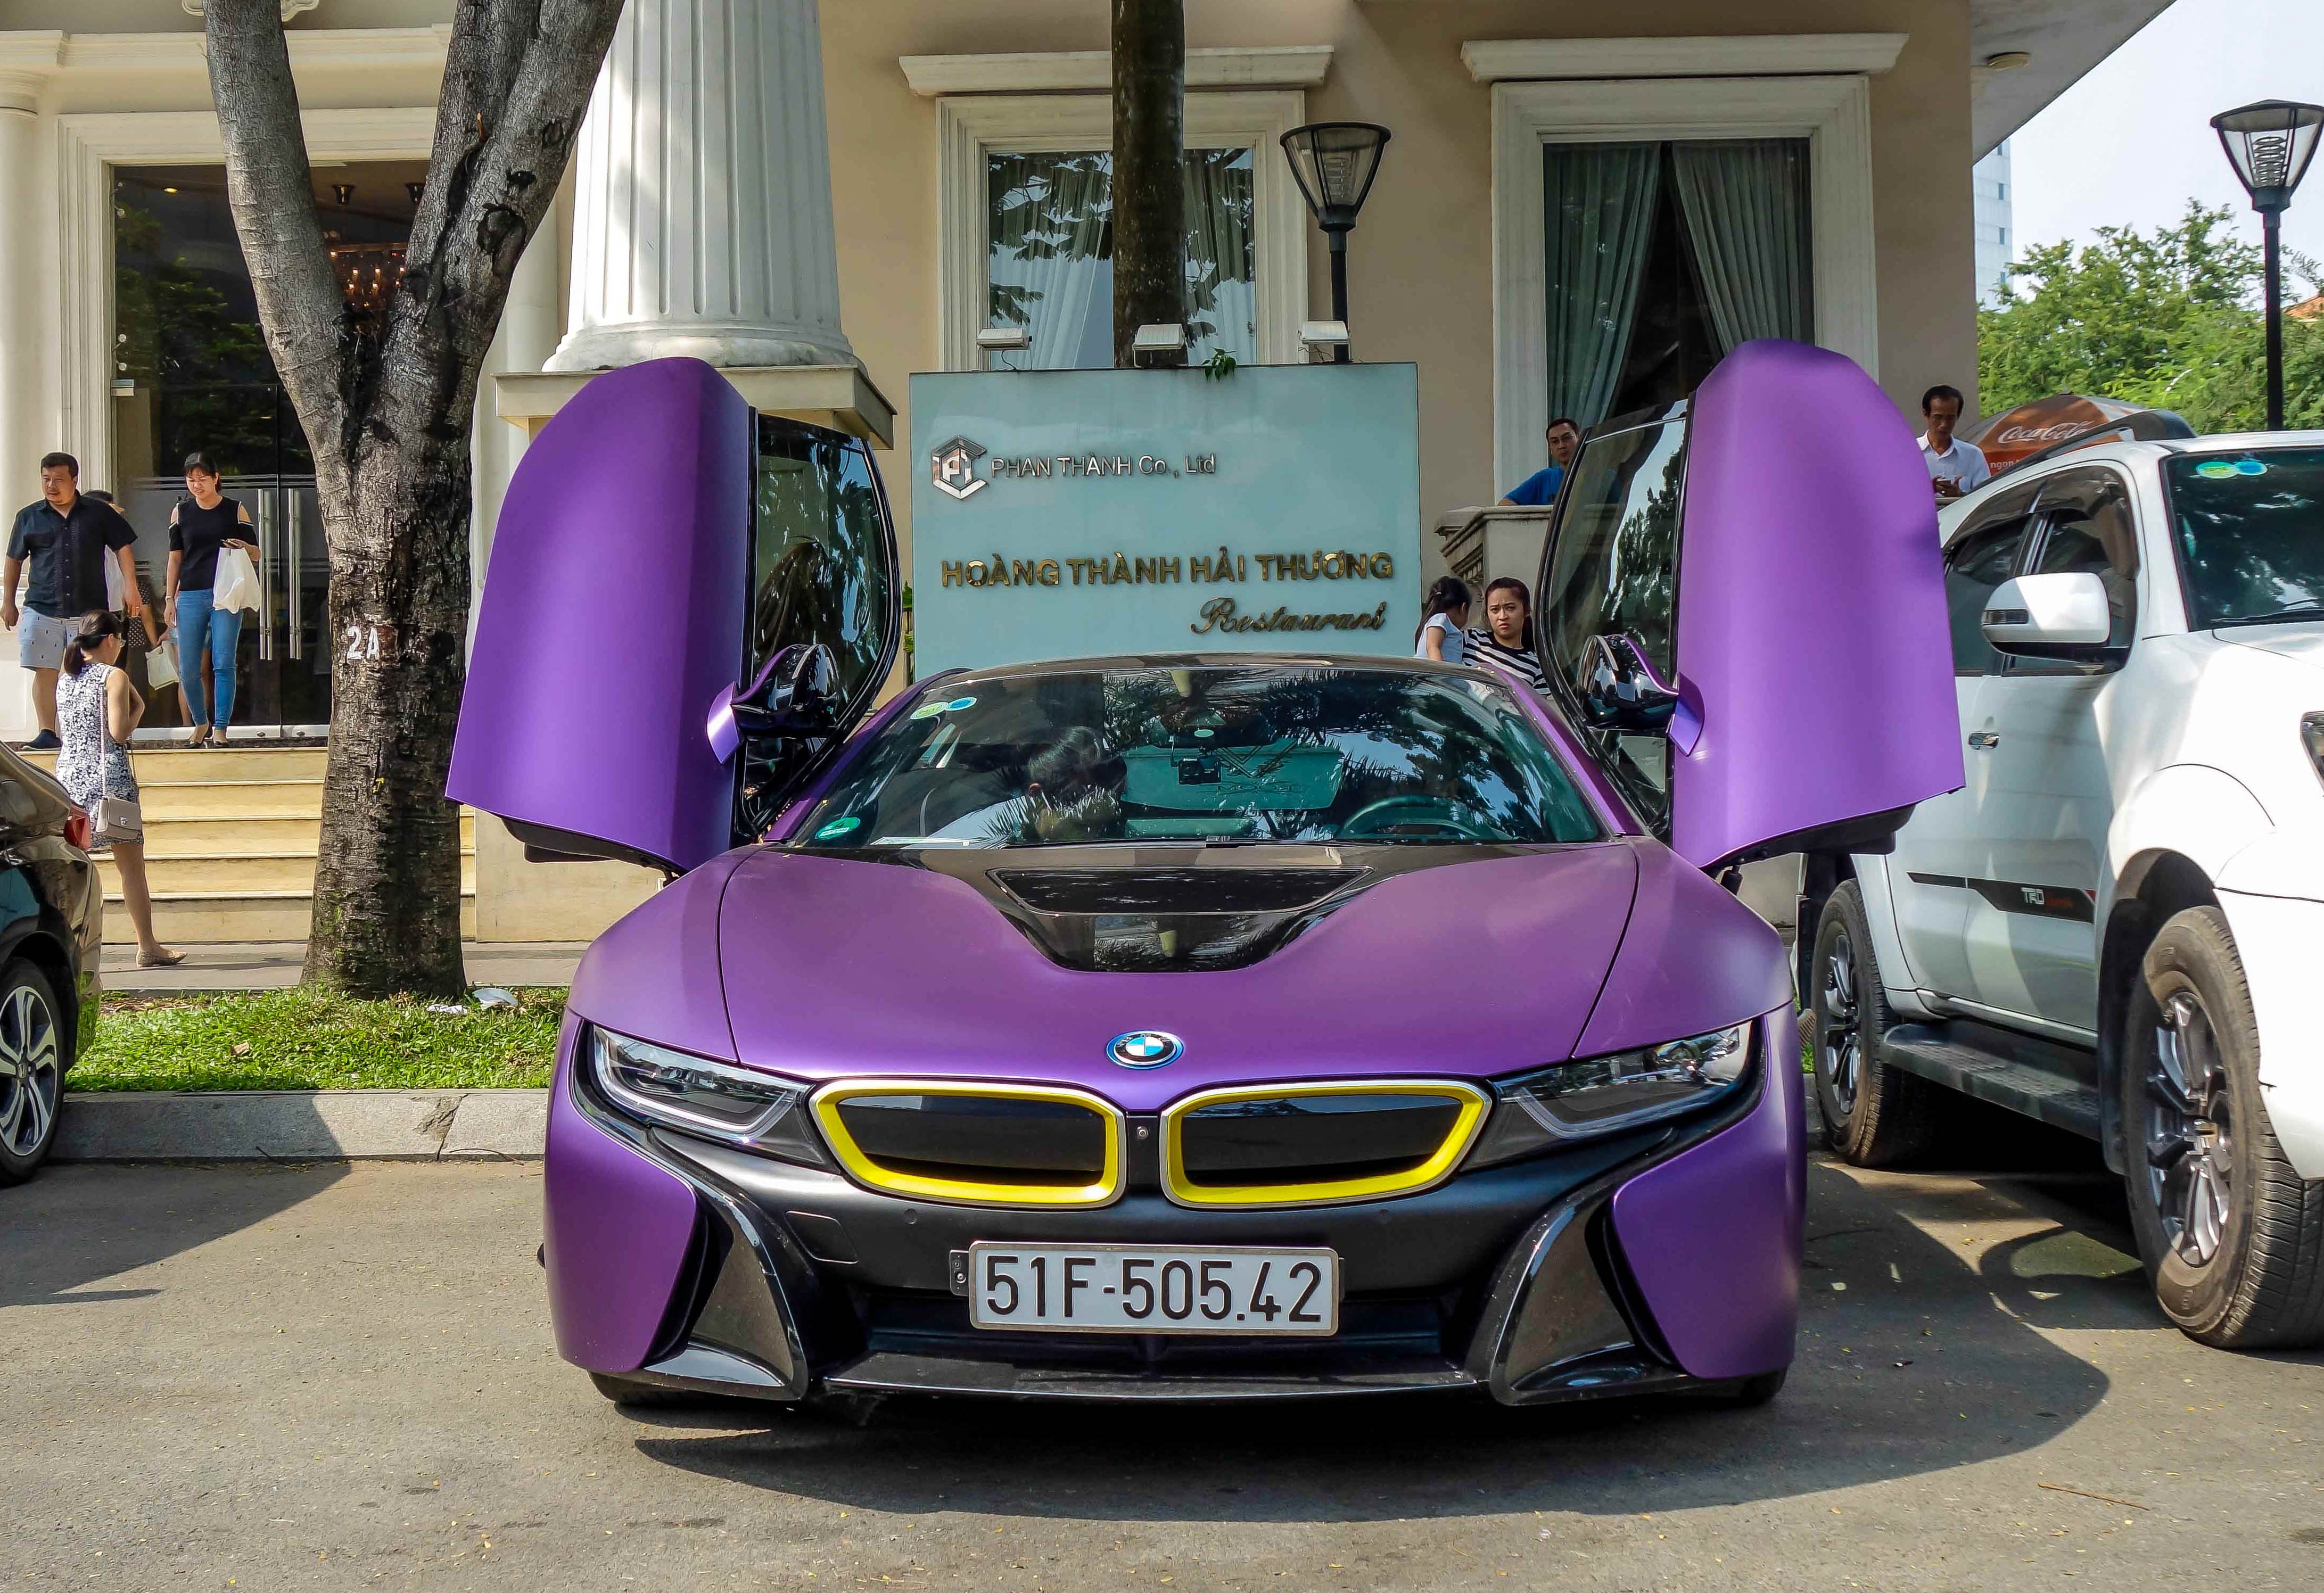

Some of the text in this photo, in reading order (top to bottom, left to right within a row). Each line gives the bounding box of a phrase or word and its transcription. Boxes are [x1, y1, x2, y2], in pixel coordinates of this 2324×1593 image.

[1998, 420, 2095, 443] Coca-Col
[991, 457, 1051, 477] PHAN
[1057, 451, 1132, 477] THÀNH
[1184, 453, 1216, 474] Ltd
[941, 546, 1394, 587] HOÀNG THÀNH HẢI THƯƠNG
[1190, 597, 1387, 634] Restaurant
[347, 625, 380, 660] 2A
[986, 1255, 1322, 1322] 51F-505.42
